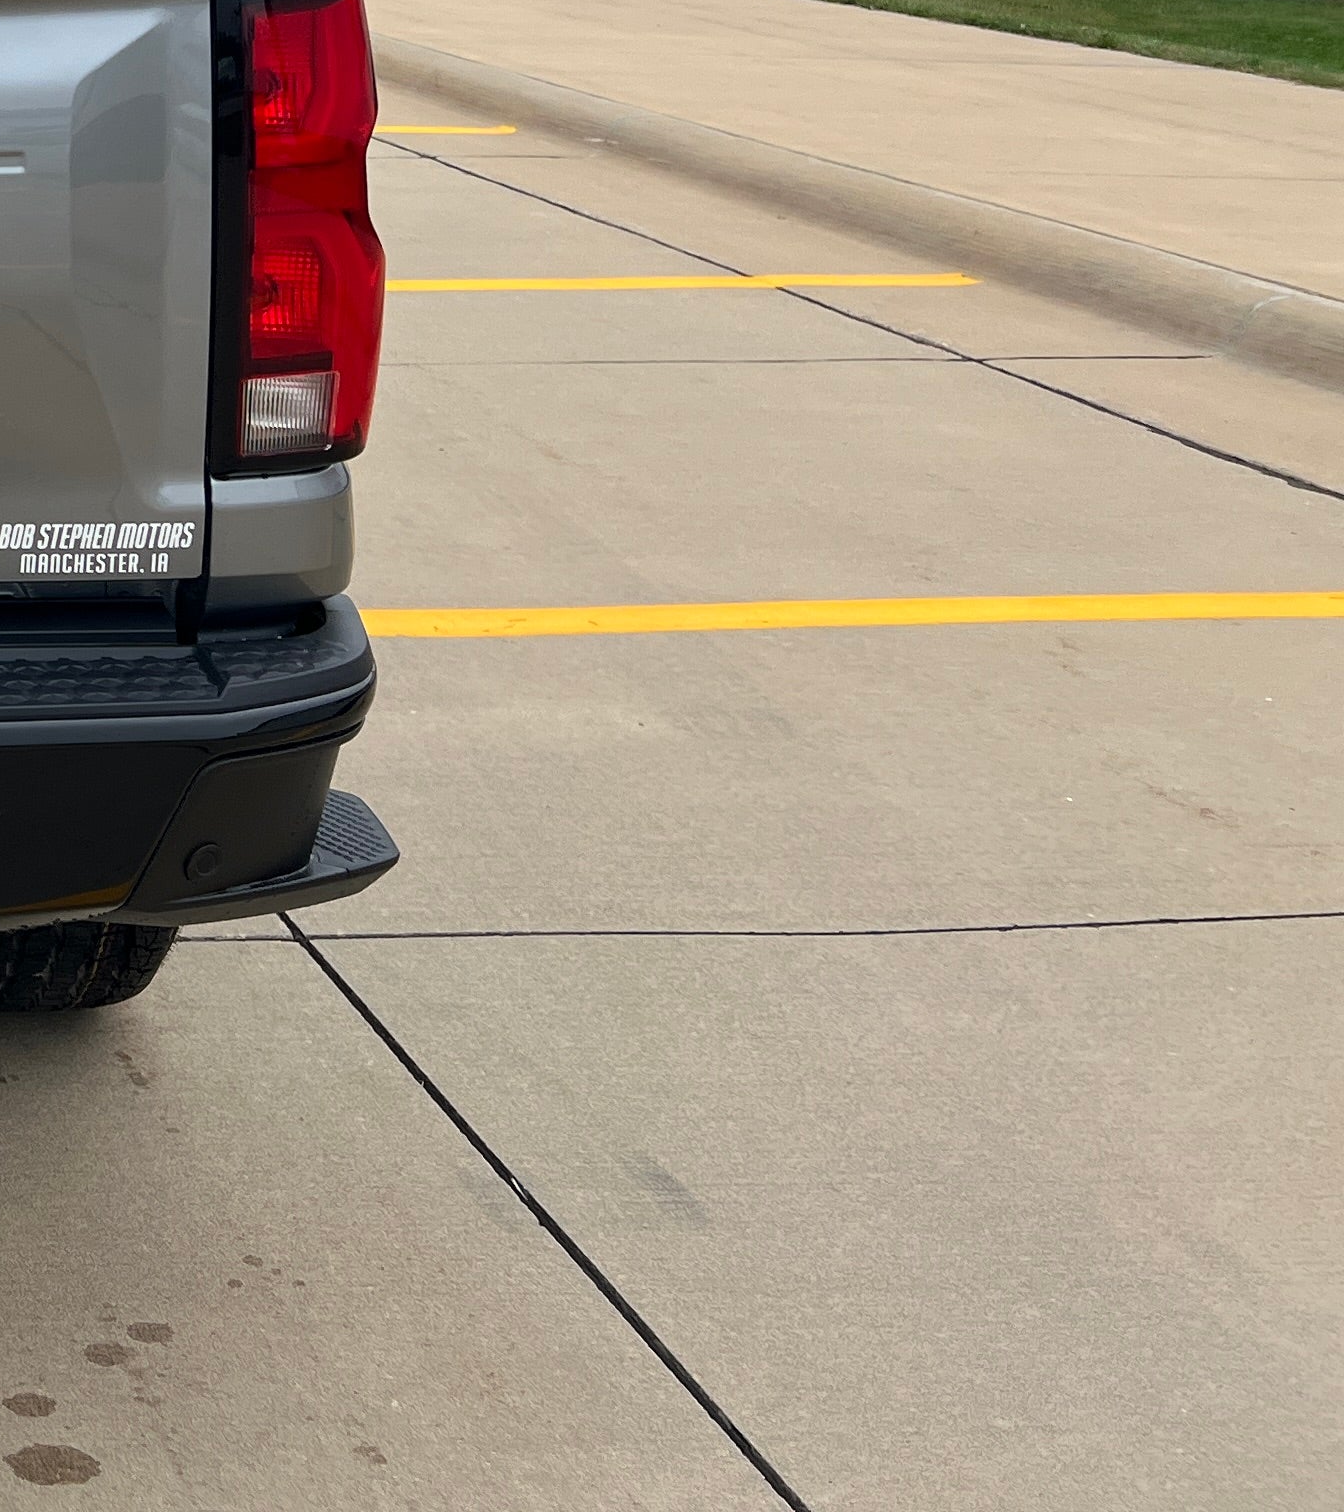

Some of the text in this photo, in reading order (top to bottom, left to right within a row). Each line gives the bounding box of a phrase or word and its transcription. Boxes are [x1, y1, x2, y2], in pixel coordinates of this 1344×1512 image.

[37, 523, 117, 549] STEPHEN
[117, 522, 196, 549] MOTORS
[151, 553, 169, 573] IA
